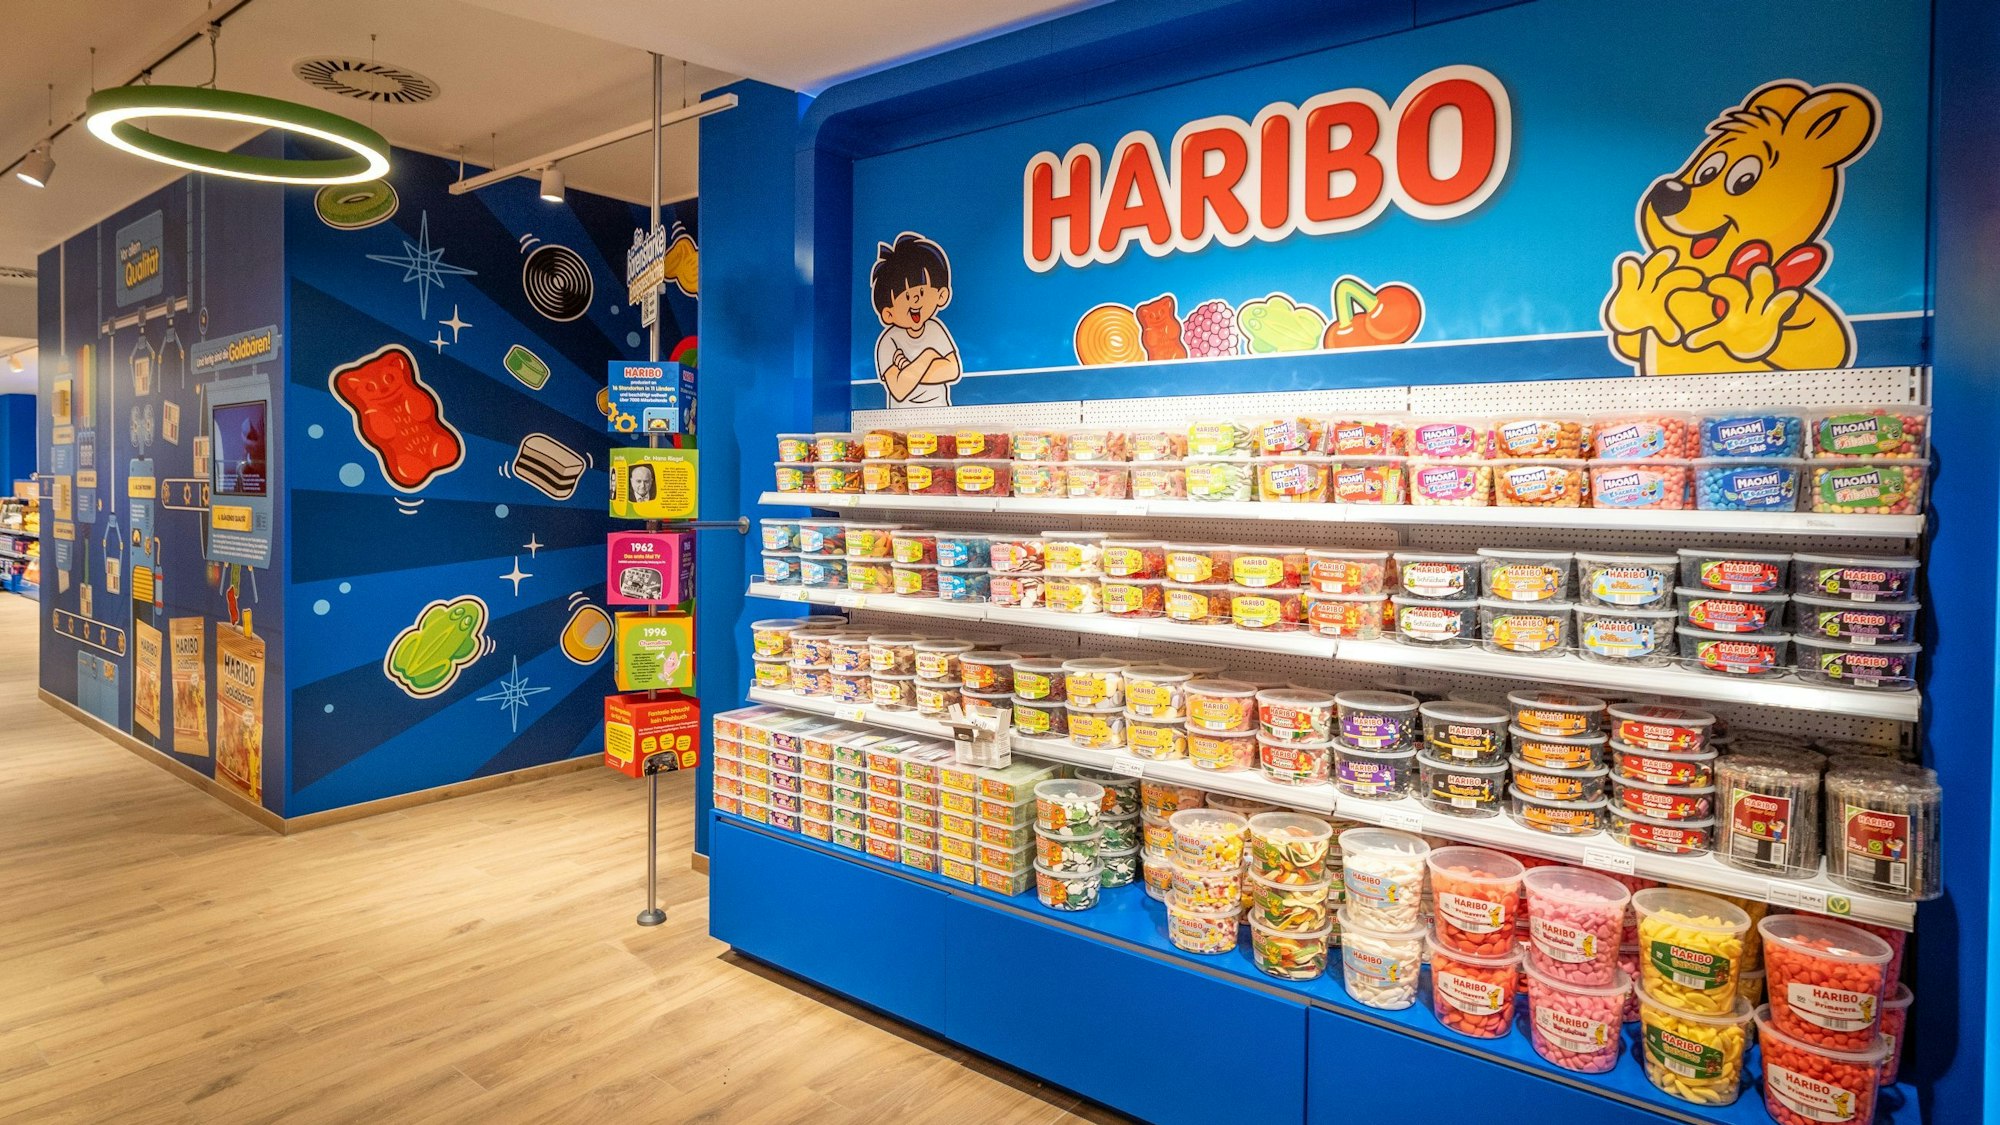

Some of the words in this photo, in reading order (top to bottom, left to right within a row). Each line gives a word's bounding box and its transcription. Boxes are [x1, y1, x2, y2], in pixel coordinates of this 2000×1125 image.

[1031, 78, 1496, 263] HARIBO
[126, 246, 159, 287] Qualität
[228, 331, 271, 362] Goldbären!
[624, 367, 662, 378] HARIBO
[1264, 424, 1289, 438] MAOAM
[1423, 426, 1456, 441] MAOAM
[1505, 424, 1537, 440] MAOAM
[1720, 422, 1764, 439] MAOAM
[1832, 420, 1877, 436] MAOAM
[1267, 437, 1287, 446] Bloxx
[1604, 427, 1639, 447] MAOAM
[1750, 443, 1766, 454] blue
[1271, 467, 1300, 481] MAOAM
[1424, 470, 1457, 485] MAOAM
[1511, 470, 1546, 486] MAOAM
[1276, 480, 1299, 490] Bloxx
[1604, 474, 1640, 491] MAOAM
[1735, 473, 1780, 491] MAOAM
[1833, 473, 1879, 489] MAOAM
[1766, 494, 1781, 505] blue
[631, 543, 654, 552] 1962
[1319, 563, 1345, 571] HARIBO
[1416, 566, 1446, 574] HARIBO
[1724, 564, 1761, 573] HARIBO
[1508, 569, 1542, 577] HARIBO
[1610, 571, 1647, 579] HARIBO
[1845, 570, 1886, 582] HARIBO
[1849, 582, 1879, 592] Viola
[1318, 604, 1344, 613] HARIBO
[1707, 603, 1744, 613] HARIBO
[1412, 610, 1443, 618] HARIBO
[1845, 614, 1886, 626] HARIBO
[644, 628, 667, 637] 1996
[1598, 623, 1634, 632] HARIBO
[1849, 625, 1879, 635] Viola
[141, 639, 157, 657] HARIBO
[175, 637, 198, 655] HARIBO
[1719, 644, 1757, 654] HARIBO
[1847, 655, 1888, 668] HARIBO
[224, 653, 256, 688] HARIBO
[1851, 666, 1882, 676] Viola
[1018, 673, 1036, 682] HARIBO
[1072, 679, 1093, 687] HARIBO
[1134, 687, 1156, 695] HARIBO
[1203, 702, 1230, 710] HARIBO
[1017, 708, 1036, 716] HARIBO
[1270, 708, 1297, 718] HARIBO
[1536, 713, 1564, 721] HARIBO
[663, 714, 688, 722] Drehbuch
[1072, 718, 1093, 726] HARIBO
[1353, 718, 1383, 727] HARIBO
[1135, 729, 1158, 737] HARIBO
[1449, 725, 1482, 737] HARIBO
[1643, 726, 1674, 735] HARIBO
[1643, 734, 1673, 742] Color-Rado
[1195, 740, 1218, 749] HARIBO
[1541, 746, 1569, 754] HARIBO
[1271, 749, 1297, 759] HARIBO
[1349, 763, 1379, 773] HARIBO
[1643, 760, 1673, 769] HARIBO
[1448, 775, 1481, 787] HARIBO
[1532, 777, 1557, 785] HARIBO
[1643, 795, 1673, 804] HARIBO
[1744, 799, 1777, 811] HARIBO
[1643, 802, 1672, 810] Color-Rado
[1547, 811, 1574, 819] HARIBO
[1858, 815, 1895, 829] HARIBO
[1653, 829, 1683, 838] HARIBO
[1178, 834, 1200, 846] HARIBO
[1653, 836, 1682, 844] Color-Rado
[1352, 872, 1381, 886] HARIBO
[1454, 897, 1488, 911] HARIBO
[1455, 907, 1486, 918] Primavera
[1178, 918, 1203, 929] HARIBO
[1542, 922, 1576, 939] HARIBO
[1353, 951, 1382, 965] HARIBO
[1671, 947, 1713, 964] HARIBO
[1453, 977, 1487, 993] HARIBO
[1454, 988, 1485, 1000] Primavera
[1813, 988, 1858, 1004] HARIBO
[1815, 1001, 1856, 1013] Primavera
[1552, 1012, 1588, 1029] HARIBO
[1661, 1032, 1702, 1053] HARIBO
[1785, 1072, 1830, 1095] HARIBO
[1787, 1086, 1829, 1104] Primavera
